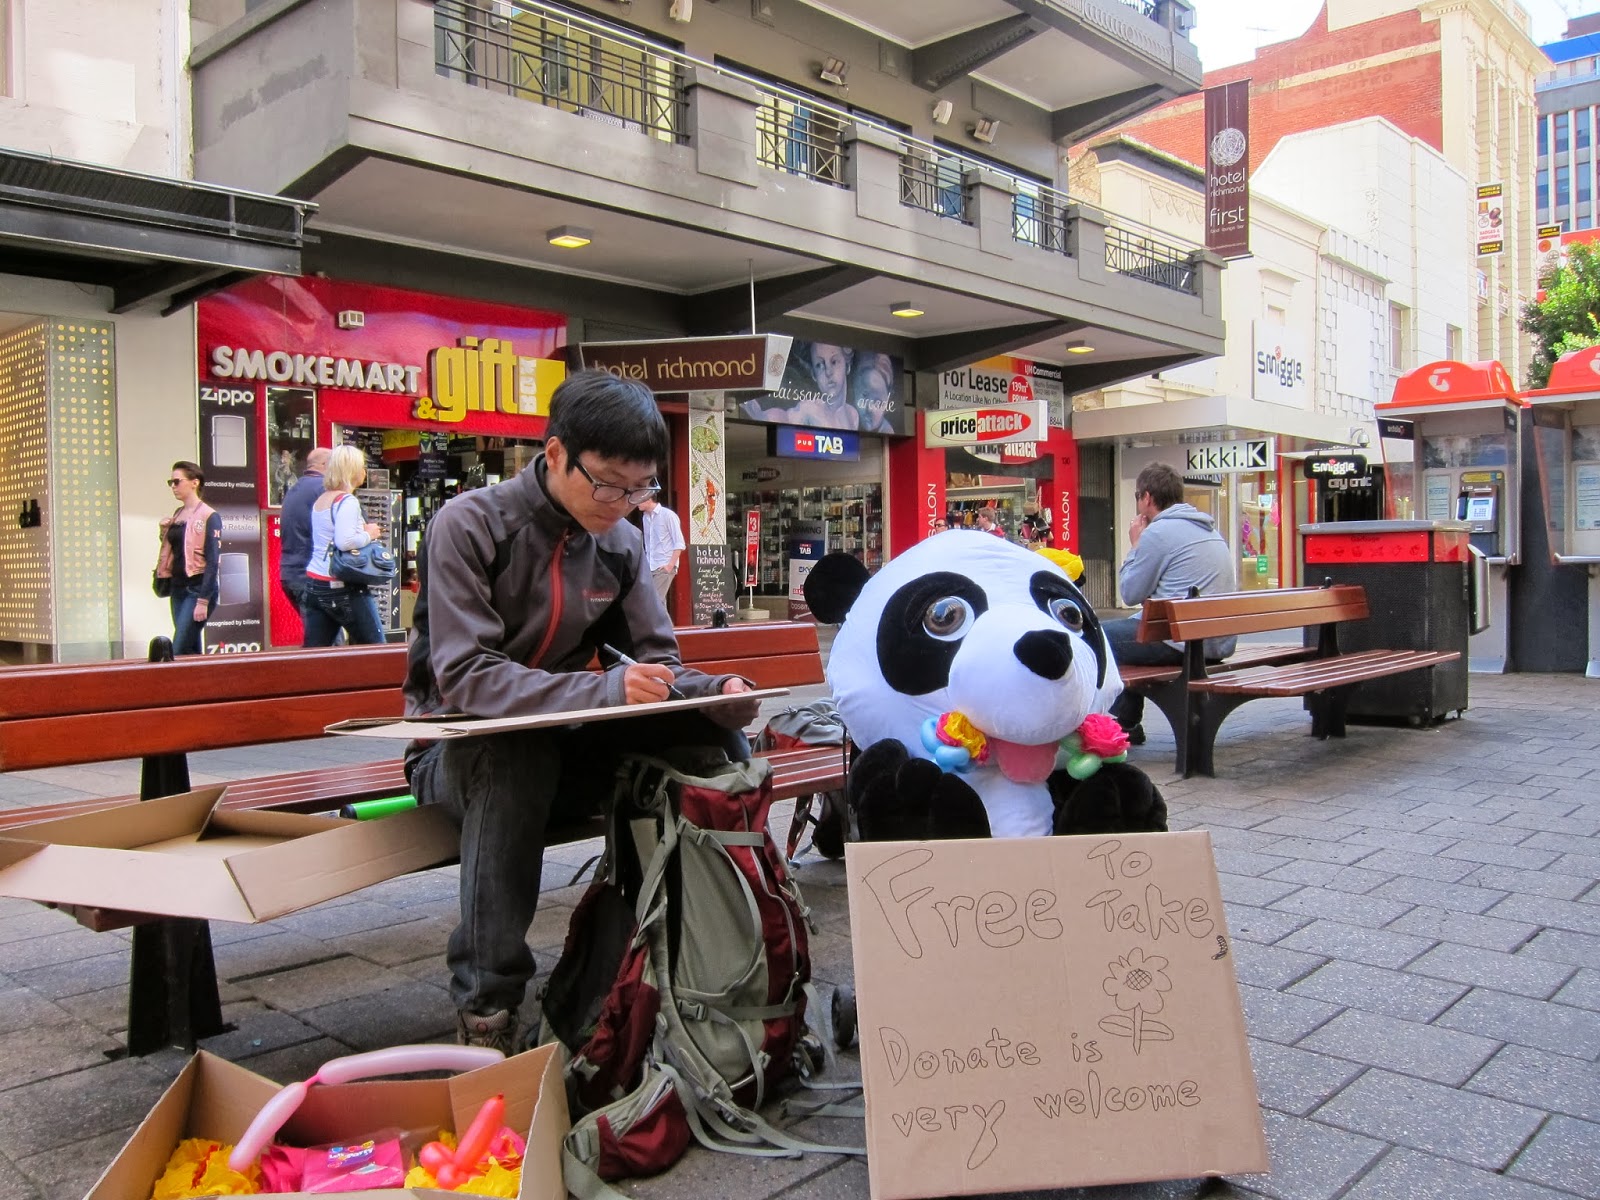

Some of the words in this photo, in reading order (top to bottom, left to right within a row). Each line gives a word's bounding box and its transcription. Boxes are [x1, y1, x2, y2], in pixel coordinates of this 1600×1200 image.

[1210, 167, 1245, 187] hotel
[1210, 184, 1245, 198] richmond
[1210, 205, 1245, 227] first
[657, 353, 756, 379] richmond
[1257, 346, 1303, 387] smiggle
[211, 345, 422, 393] SMOKEMART
[416, 397, 438, 419] &
[433, 335, 519, 423] gift
[969, 368, 1008, 394] Lease
[857, 392, 896, 413] arcade
[949, 392, 972, 403] Location
[972, 395, 984, 405] Like
[984, 396, 992, 405] No
[941, 417, 976, 437] price
[977, 414, 1023, 433] attack
[815, 435, 844, 455] TAB
[1186, 441, 1267, 470] kikki.K
[1312, 459, 1356, 475] smiggle
[1062, 491, 1070, 541] SALON
[697, 545, 723, 558] hotel
[862, 848, 1064, 960] Free
[879, 1027, 1041, 1087] Donate
[1071, 1032, 1104, 1063] is
[892, 1100, 1006, 1171] very
[1034, 1069, 1202, 1119] welcome
